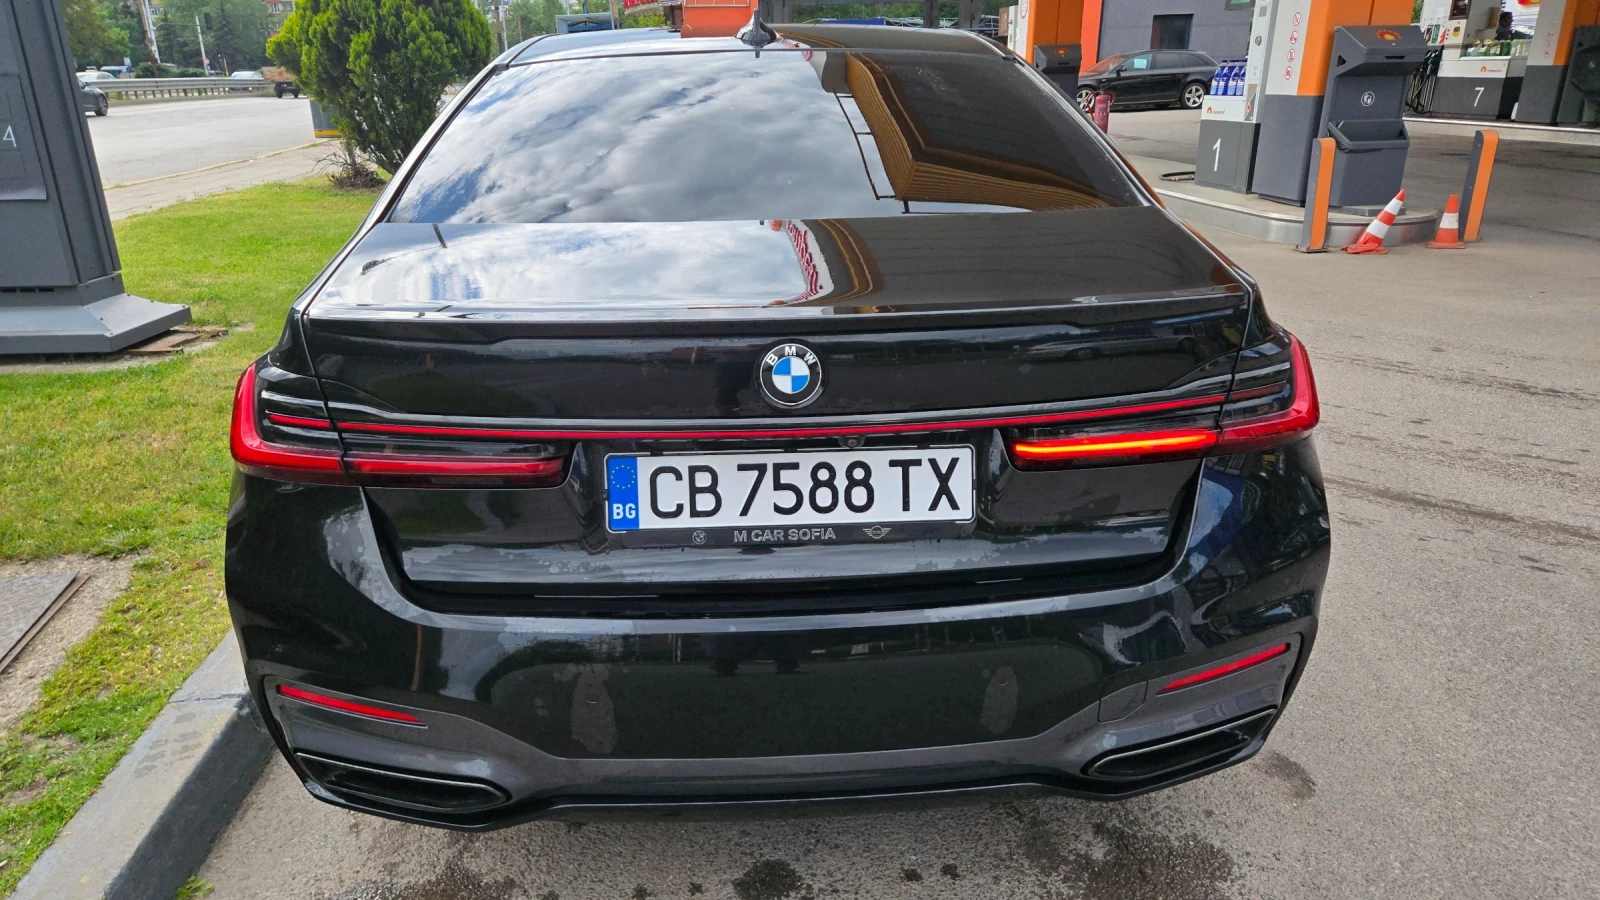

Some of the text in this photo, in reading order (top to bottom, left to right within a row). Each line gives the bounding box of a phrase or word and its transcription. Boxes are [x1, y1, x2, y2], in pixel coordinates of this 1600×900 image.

[1474, 86, 1485, 107] 7
[3, 125, 17, 148] 4
[1212, 137, 1221, 172] 1
[765, 345, 817, 367] BMW
[649, 457, 961, 520] CB 7588 TX
[612, 502, 637, 520] BG
[733, 527, 837, 543] M CAR SOFIA
